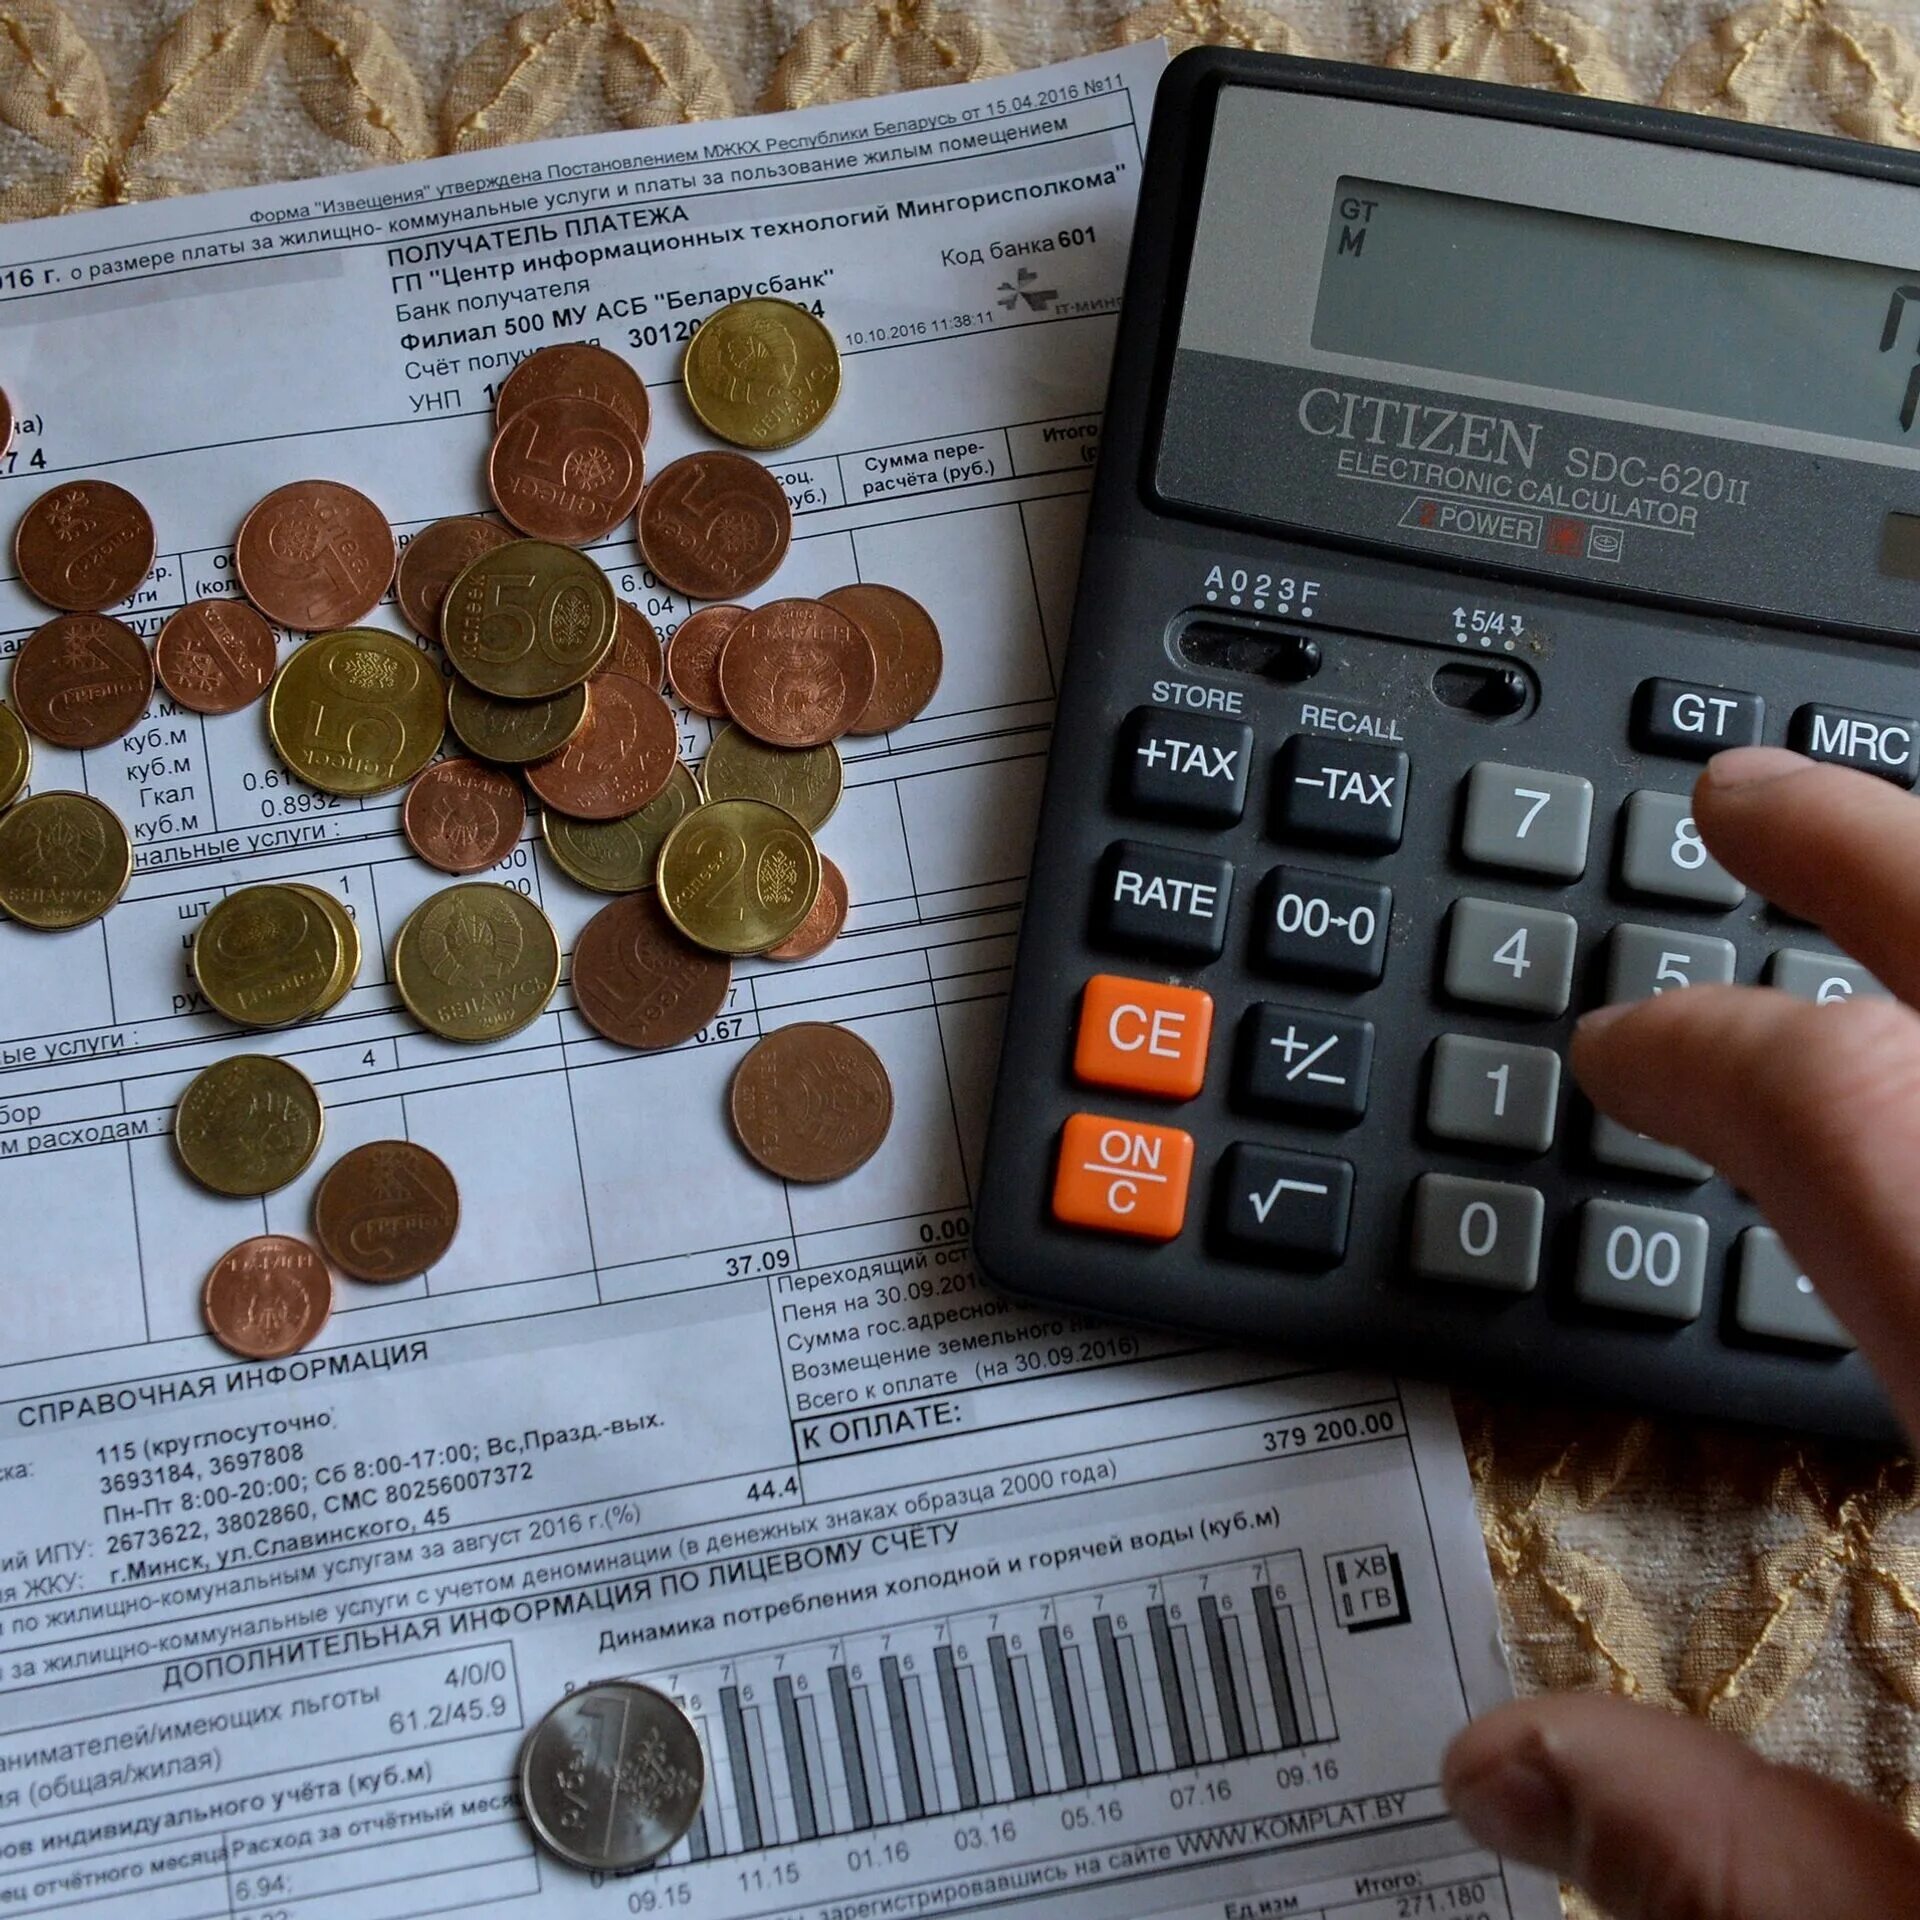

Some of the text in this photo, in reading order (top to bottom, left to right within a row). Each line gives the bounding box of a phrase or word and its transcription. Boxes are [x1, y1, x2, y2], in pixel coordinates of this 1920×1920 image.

[250, 86, 1078, 225] Форма "Извещения" утверждена Постановлением МЖКХ Республики Беларусь 15.04.2016
[89, 117, 1068, 280] размере платы жилищно- коммунальные услуги платы пользование жилым помещением
[1339, 197, 1379, 224] GT
[388, 205, 689, 266] ПОЛУЧАТЕЛЬ ПЛАТЕЖА
[392, 164, 1126, 293] ГП "Центр информационных технологий Мингорисполкома"
[941, 226, 1096, 267] Код банка 601
[1337, 226, 1366, 258] M
[396, 279, 590, 322] Банк получателя
[400, 324, 496, 351] Филиал
[505, 313, 544, 335] 500
[552, 305, 587, 328] МУ
[596, 296, 648, 321] АСБ
[654, 269, 834, 312] "Беларусбанк"
[846, 311, 993, 347] 10.10.2016 11:38:11
[405, 358, 461, 380] Счёт
[409, 390, 461, 413] УНП
[1299, 386, 1543, 470] CITIZEN
[866, 441, 985, 471] Сумма пере-
[863, 459, 995, 497] расчёта (руб.)
[1337, 449, 1699, 530] ELECTRONIC CALCULATOR
[1440, 510, 1534, 543] POWER
[1204, 565, 1224, 590] A
[1253, 573, 1270, 596] 2
[1278, 578, 1295, 601] 3
[1301, 581, 1320, 603] F
[1471, 609, 1505, 633] 5/4
[1152, 680, 1243, 714] STORE
[1672, 693, 1738, 737] GT
[123, 728, 187, 754] куб.м
[1300, 704, 1404, 741] RECALL
[1812, 714, 1911, 766] MRC
[127, 757, 190, 783] куб.м
[1137, 738, 1239, 781] +TAX
[140, 786, 194, 807] Гкал
[1513, 788, 1551, 838] 7
[135, 815, 198, 839] куб.м
[248, 824, 327, 852] услуги
[1671, 817, 1707, 869] 8
[1114, 870, 1217, 918] RATE
[1493, 928, 1532, 978] 4
[1654, 952, 1690, 996] 5
[437, 977, 548, 1024] БЕЛАРУСЬ
[45, 1033, 124, 1061] услуги
[1108, 1004, 1186, 1059] CE
[1486, 1064, 1510, 1116] 1
[28, 1120, 149, 1151] расходам
[1100, 1130, 1162, 1169] ON
[1107, 1180, 1138, 1214] C
[1460, 1202, 1498, 1257] 0
[725, 1249, 791, 1276] 37.09
[778, 1253, 927, 1293] Переходящий
[1606, 1226, 1681, 1287] 00
[783, 1301, 838, 1323] Пеня
[787, 1327, 861, 1353] Сумма
[792, 1344, 931, 1382] Возмещение
[938, 1318, 1063, 1355] земельного
[18, 1341, 429, 1428] СПРАВОЧНАЯ ИНФОРМАЦИЯ
[796, 1337, 1141, 1412] Всего оплате 30.09.2016)
[829, 1401, 961, 1445] ОПЛАТЕ:
[1263, 1411, 1394, 1452] 379 200.00
[96, 1443, 136, 1466] 115
[100, 1442, 304, 1496] 3693184, 3697808
[103, 1442, 479, 1525] Пн-Пт 8:00-20:00; Сб 8:00-17:00;
[747, 1476, 798, 1503] 44.4
[106, 1461, 533, 1553] 2673622, 3802860, СМС 80256007372
[44, 1460, 1117, 1674] жилищно-коммунальные услуги деноминации денежных знаках образца 2000 года)
[46, 1566, 316, 1627] жилищно-комунальным
[322, 1548, 413, 1583] услугам
[453, 1530, 521, 1557] август
[529, 1513, 581, 1540] 2016
[110, 1553, 210, 1585] г.Минск,
[599, 1507, 1280, 1653] Динамика потребления холодной горячей воды (куб.м)
[1354, 1555, 1387, 1577] ХВ
[163, 1520, 959, 1692] ДОПОЛНИТЕЛЬНАЯ ИНФОРМАЦИЯ ПО ЛИЦЕВОМУ СЧЁТУ
[1361, 1587, 1391, 1609] ГВ
[445, 1660, 507, 1688] 4/0/0
[389, 1697, 507, 1735] 61.2/45.9
[29, 1747, 222, 1807] (общая/жилая)
[1276, 1762, 1339, 1790] 09.16
[42, 1761, 432, 1851] индивидуального (куб.м)
[1170, 1782, 1232, 1811] 07.16
[955, 1822, 1016, 1852] 03.16
[1061, 1803, 1123, 1831] 05.16
[1176, 1793, 1407, 1857] WWW.KOMPLAT.BY
[847, 1842, 909, 1872] 01.16
[738, 1863, 800, 1893] 11.15
